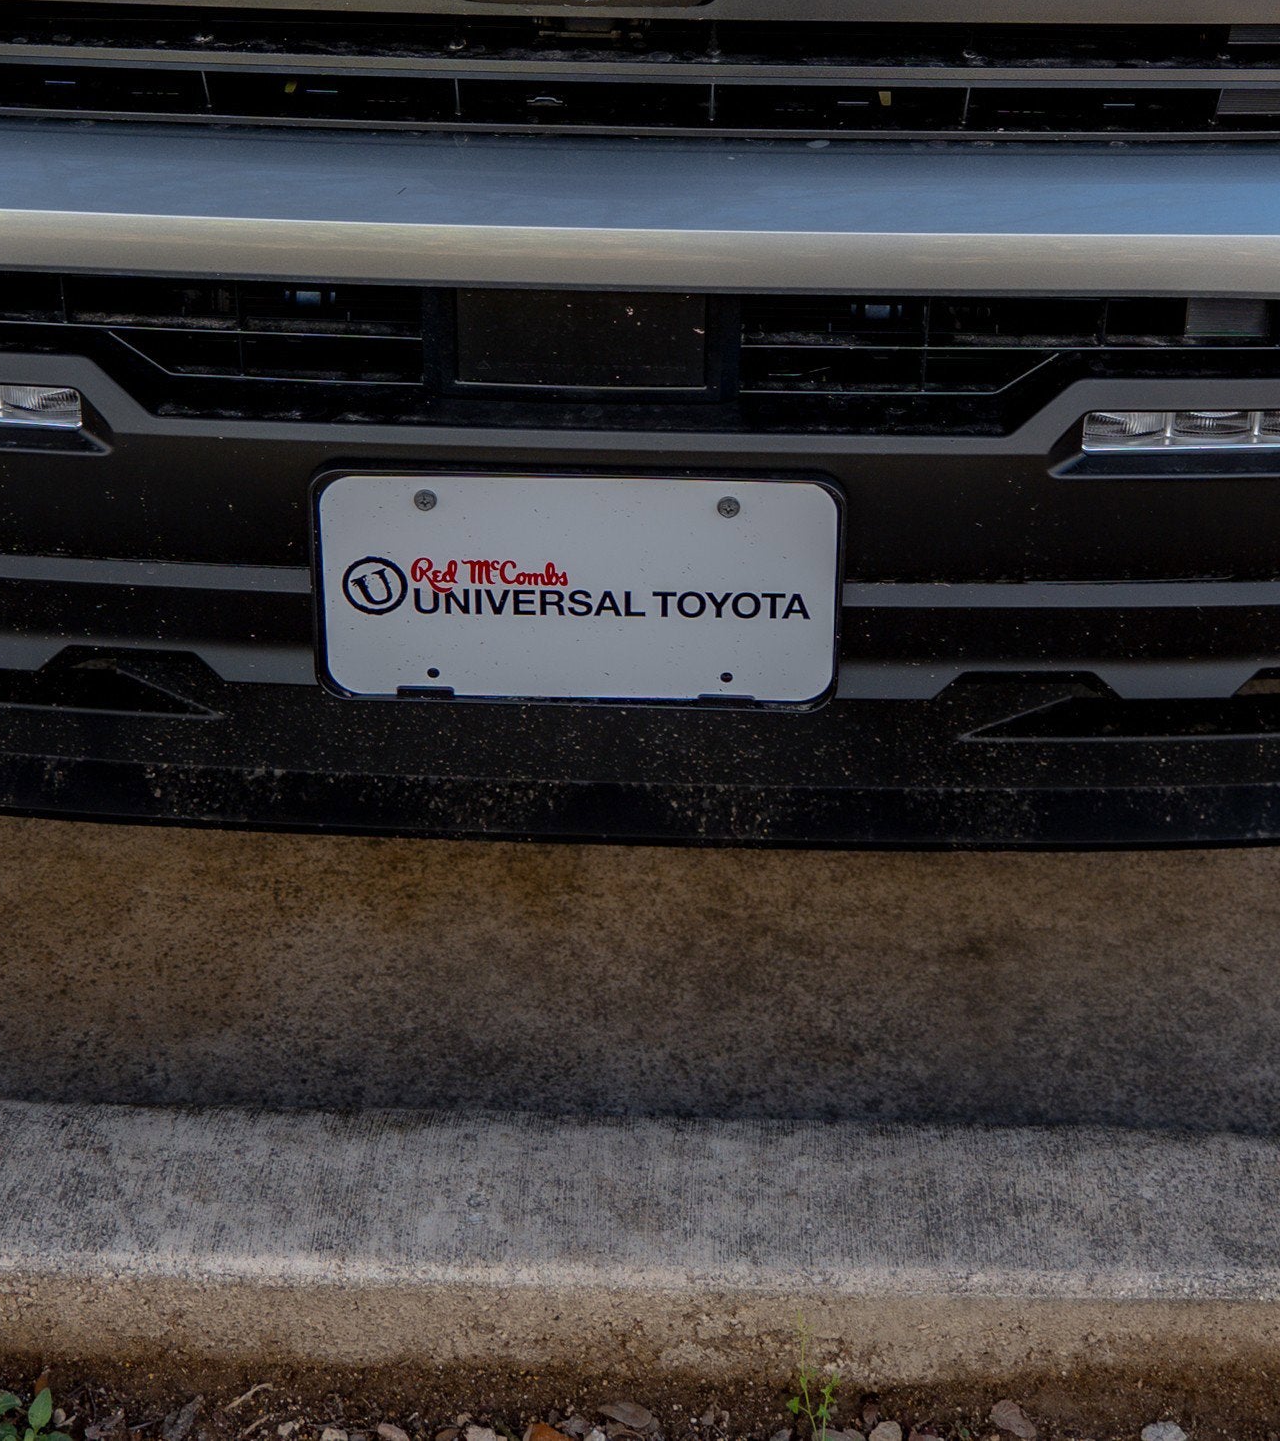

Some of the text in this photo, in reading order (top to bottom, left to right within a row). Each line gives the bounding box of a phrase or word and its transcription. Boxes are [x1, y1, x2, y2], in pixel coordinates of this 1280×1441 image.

[410, 557, 569, 593] Red McCombs
[413, 588, 811, 620] UNIVERSAL TOYOTA
